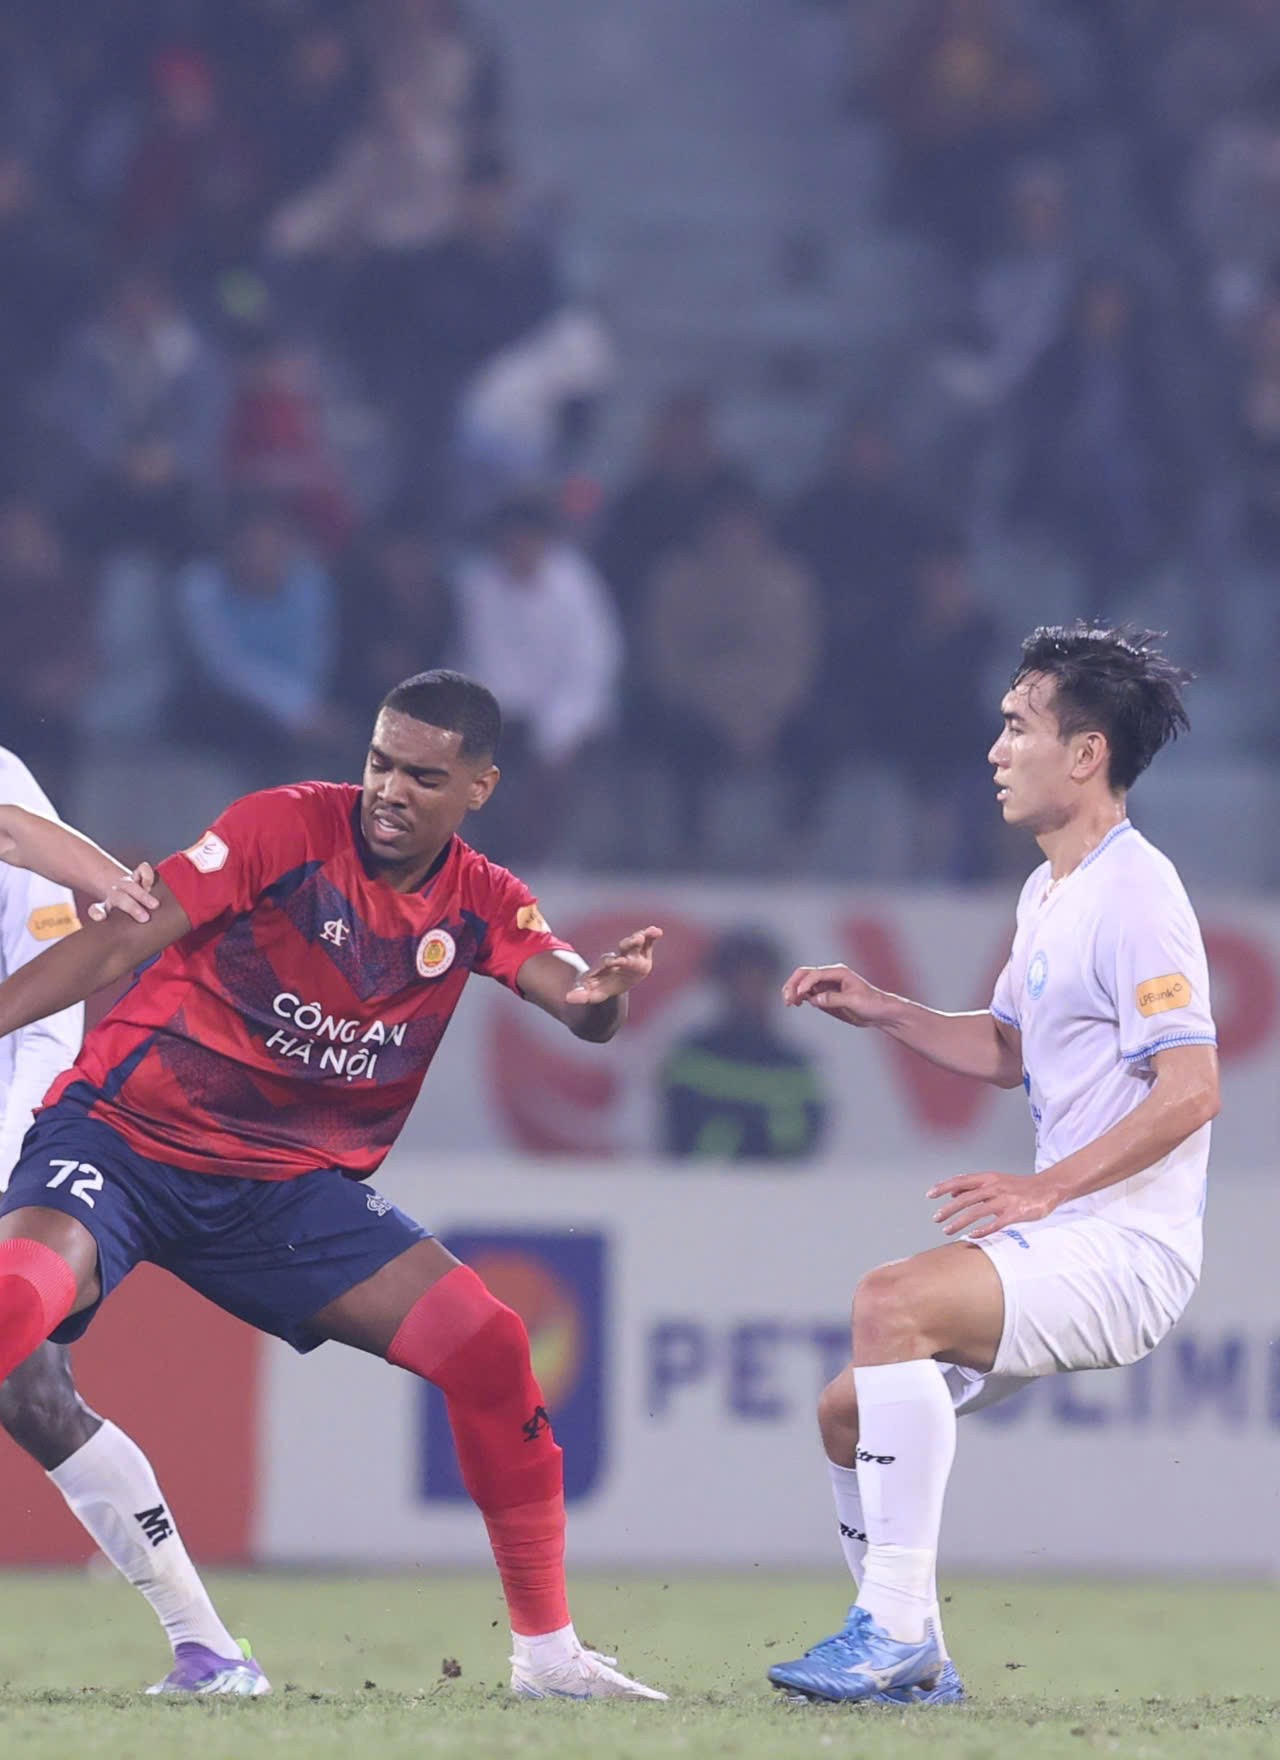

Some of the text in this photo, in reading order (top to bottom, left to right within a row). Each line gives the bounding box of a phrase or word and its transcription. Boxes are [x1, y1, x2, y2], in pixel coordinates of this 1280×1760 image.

[272, 992, 408, 1047] CÔNG AN
[265, 1029, 378, 1082] HÀ NỘI
[45, 1159, 104, 1209] 72
